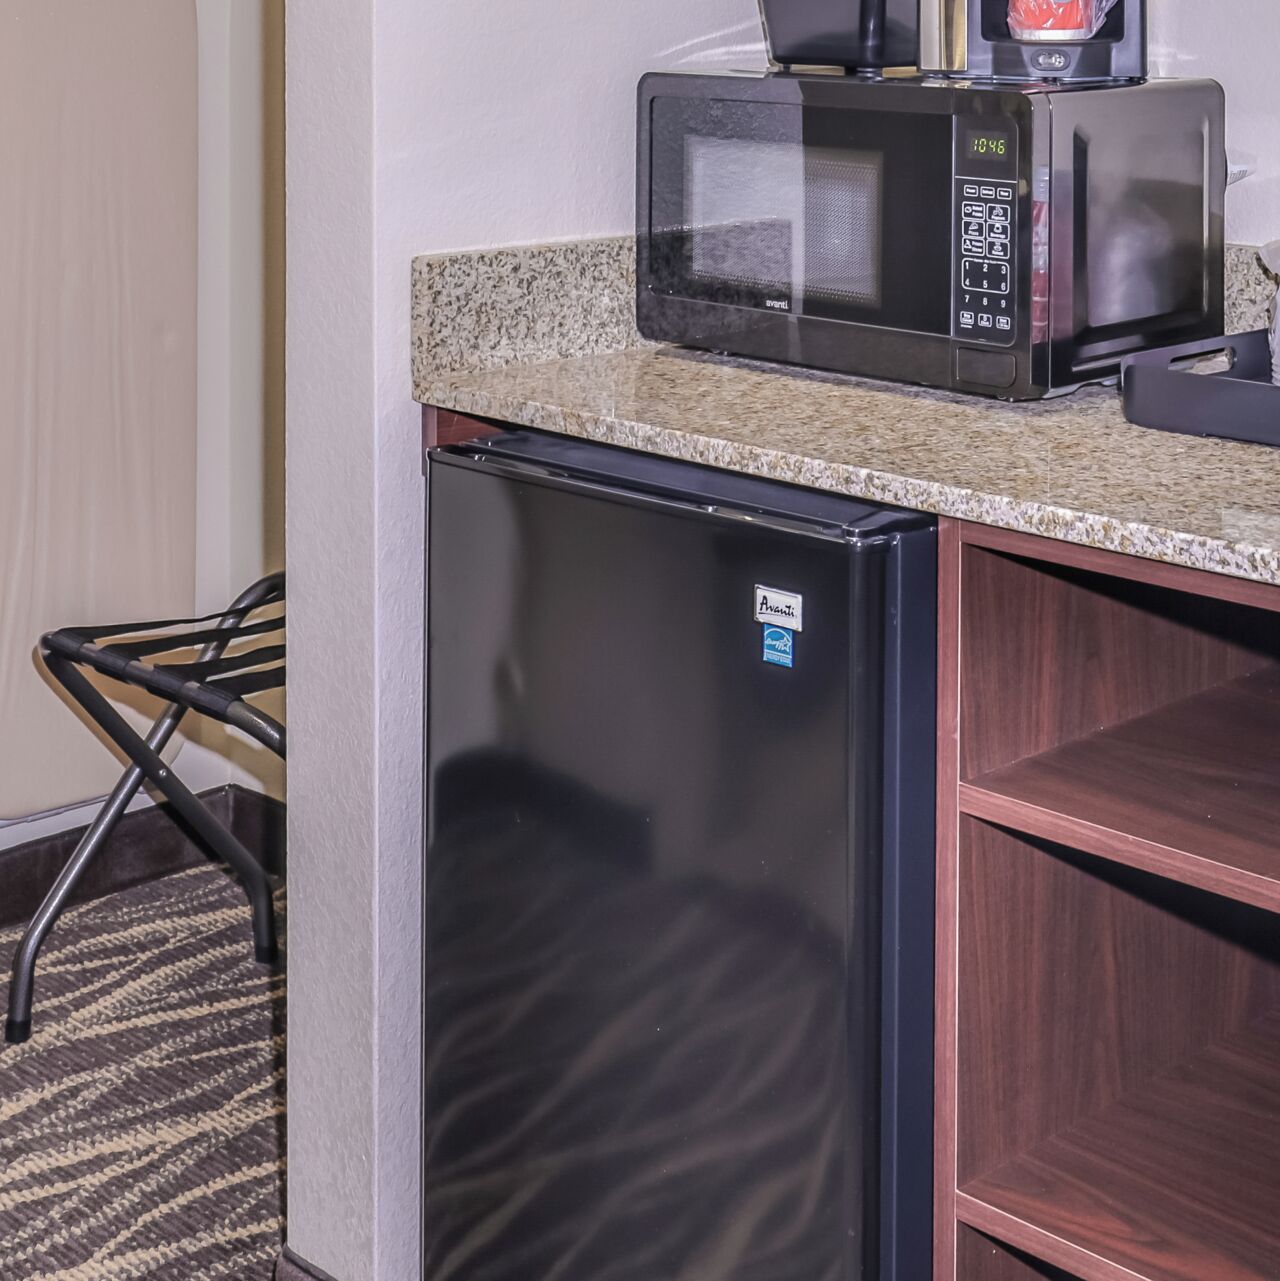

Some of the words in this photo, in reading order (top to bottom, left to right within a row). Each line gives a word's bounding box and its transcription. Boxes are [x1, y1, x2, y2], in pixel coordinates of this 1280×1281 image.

[965, 261, 969, 270] 1
[982, 264, 988, 272] 2
[1001, 265, 1006, 274] 3
[964, 278, 970, 286] 4
[983, 280, 988, 288] 5
[1001, 282, 1006, 291] 6
[964, 295, 970, 303] 7
[983, 297, 988, 306] 8
[1000, 299, 1006, 308] 9
[759, 595, 795, 618] Avanti
